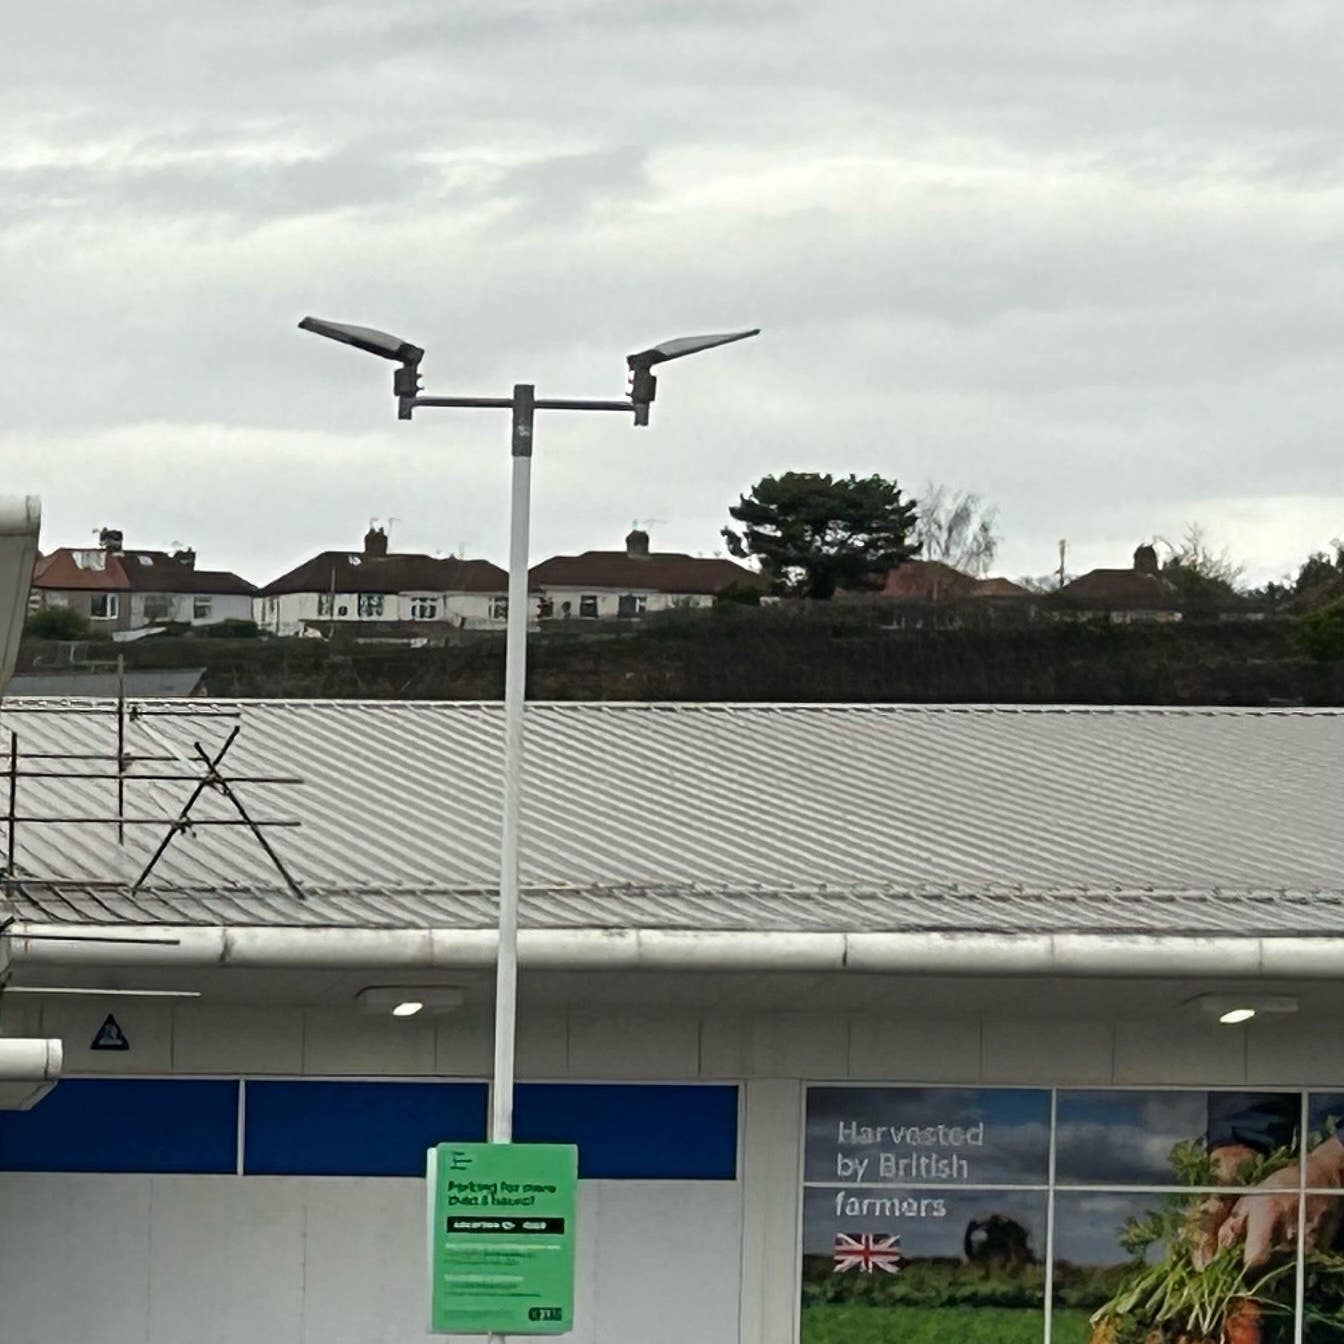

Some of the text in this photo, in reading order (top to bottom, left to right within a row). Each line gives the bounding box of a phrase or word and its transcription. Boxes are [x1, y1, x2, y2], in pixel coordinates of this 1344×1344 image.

[837, 1121, 984, 1146] Harvested
[837, 1153, 968, 1183] by British
[835, 1191, 947, 1217] farmers
